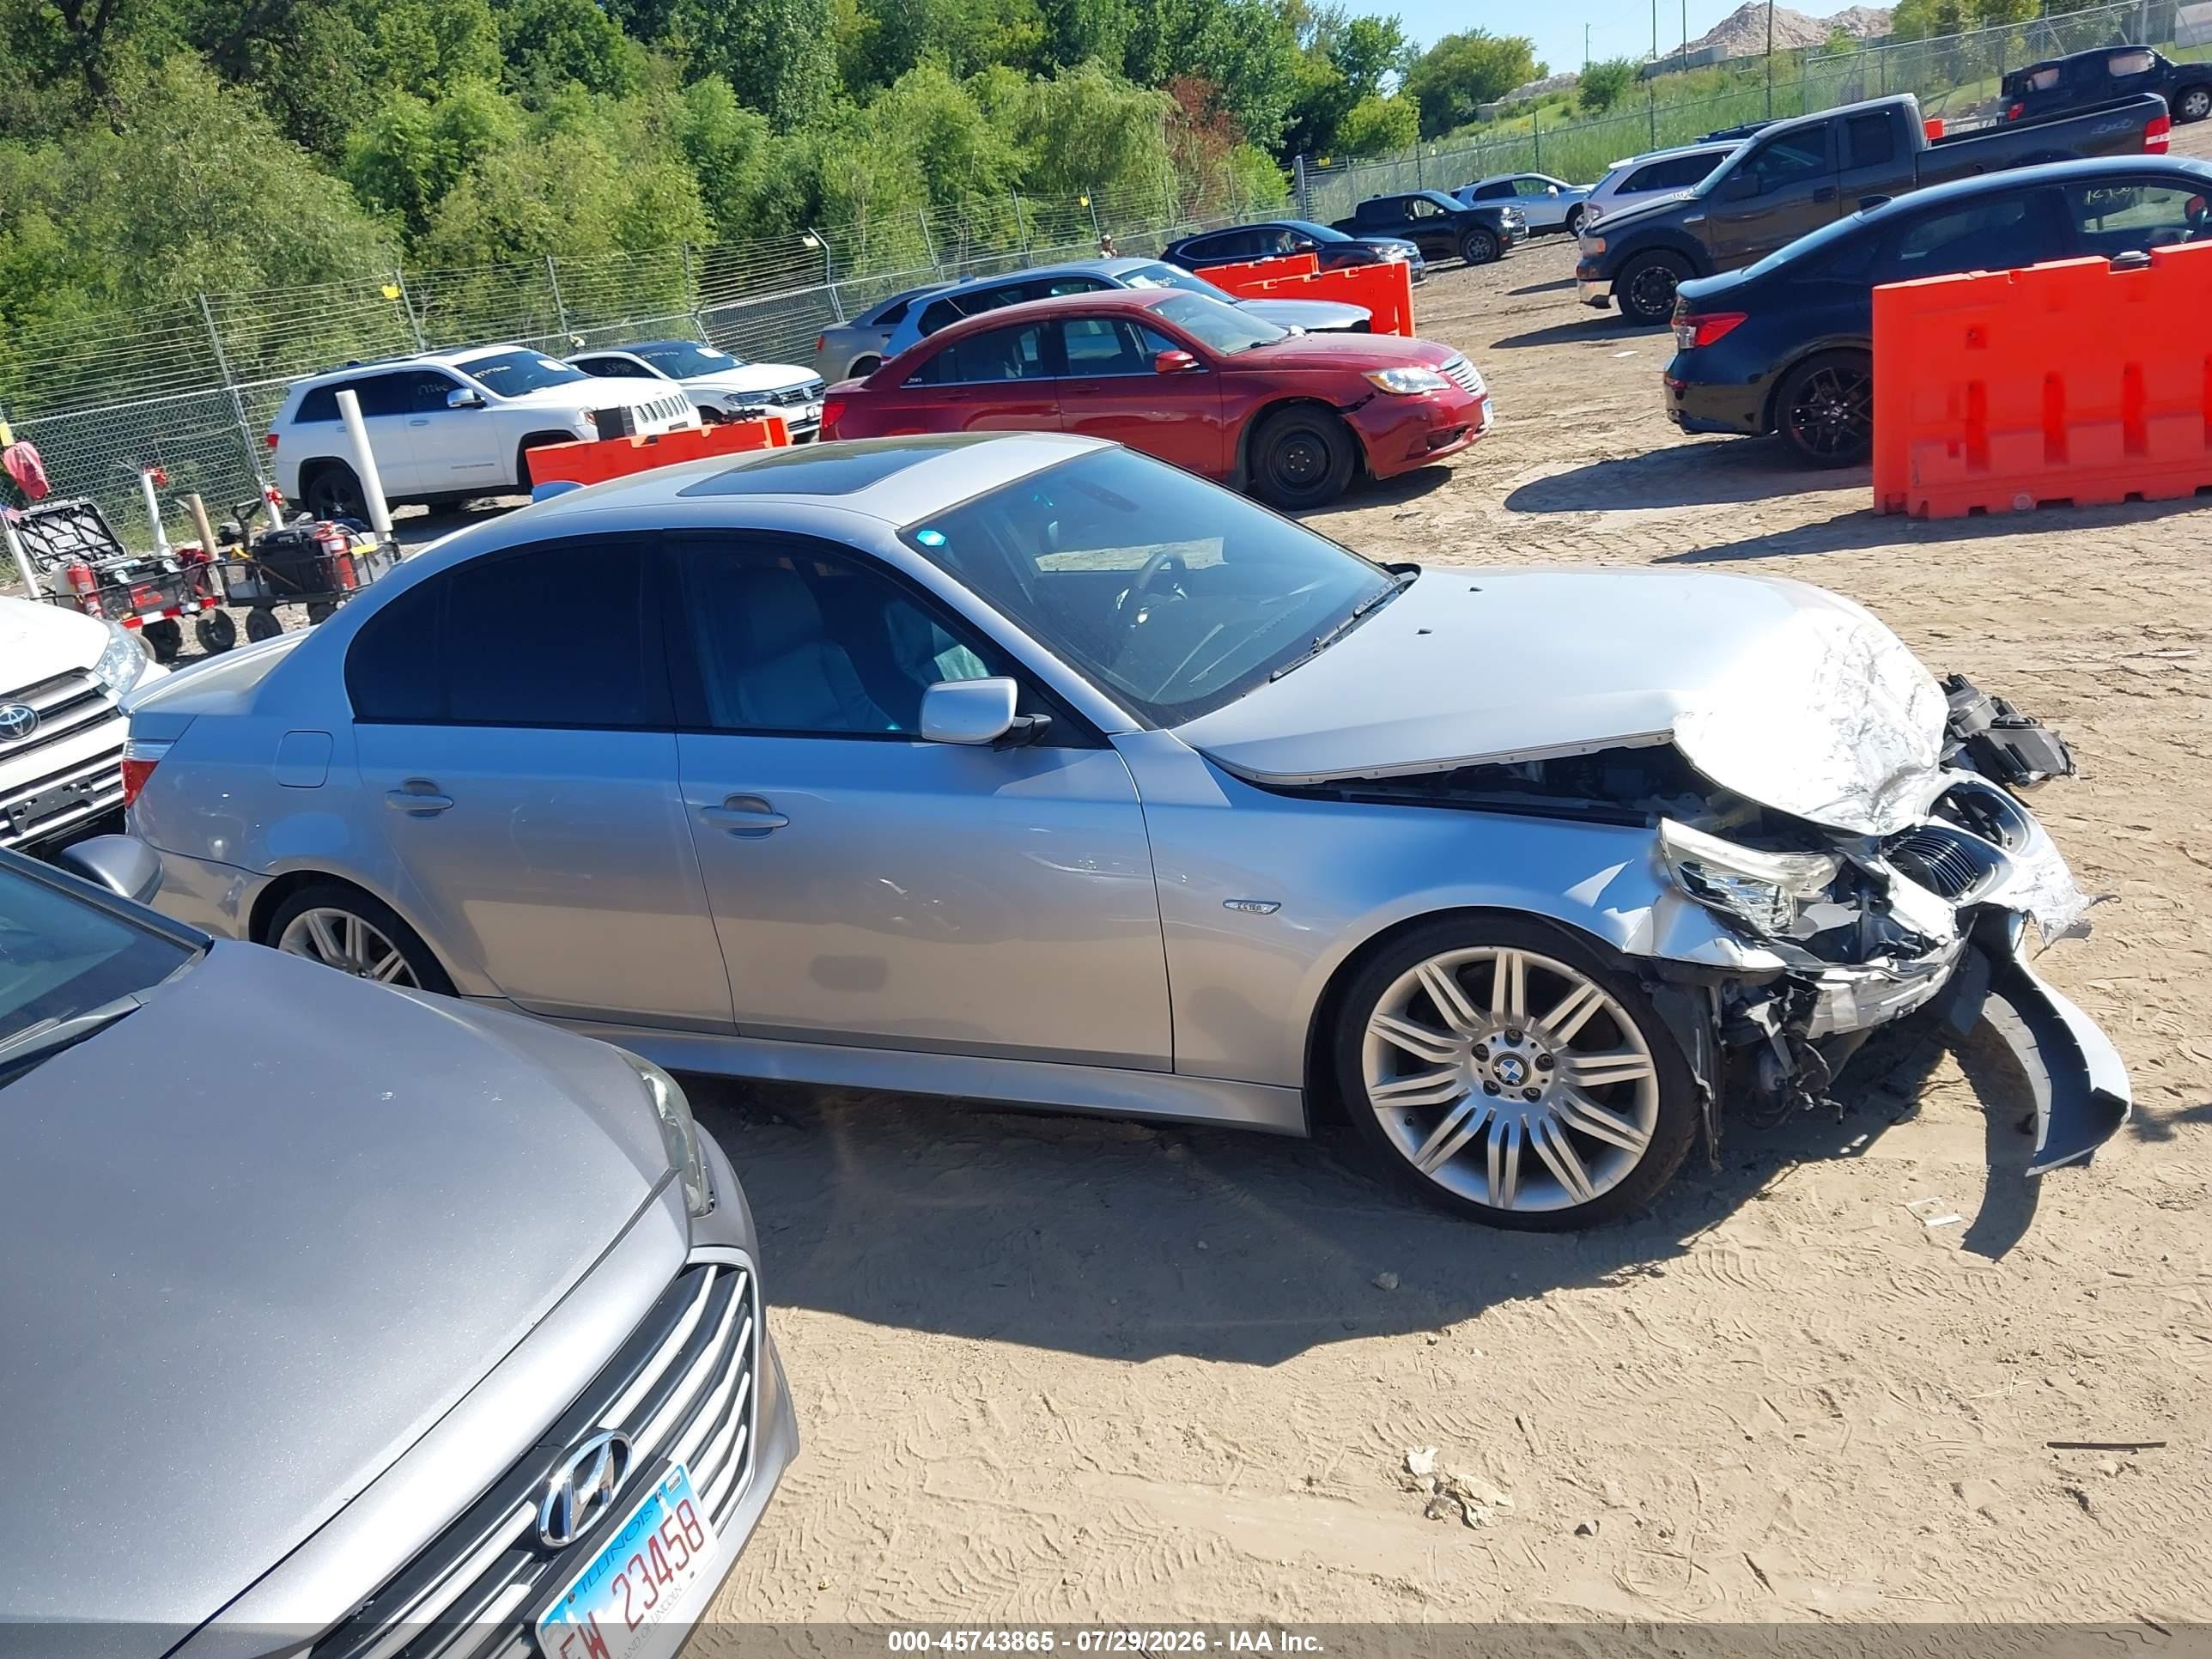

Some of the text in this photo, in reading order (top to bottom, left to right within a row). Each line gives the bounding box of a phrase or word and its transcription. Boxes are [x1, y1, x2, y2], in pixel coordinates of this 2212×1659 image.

[580, 1506, 654, 1595] ILLINOIS
[611, 1498, 705, 1633] 23458
[617, 1635, 645, 1659] AND
[650, 1584, 684, 1627] LINCOLN
